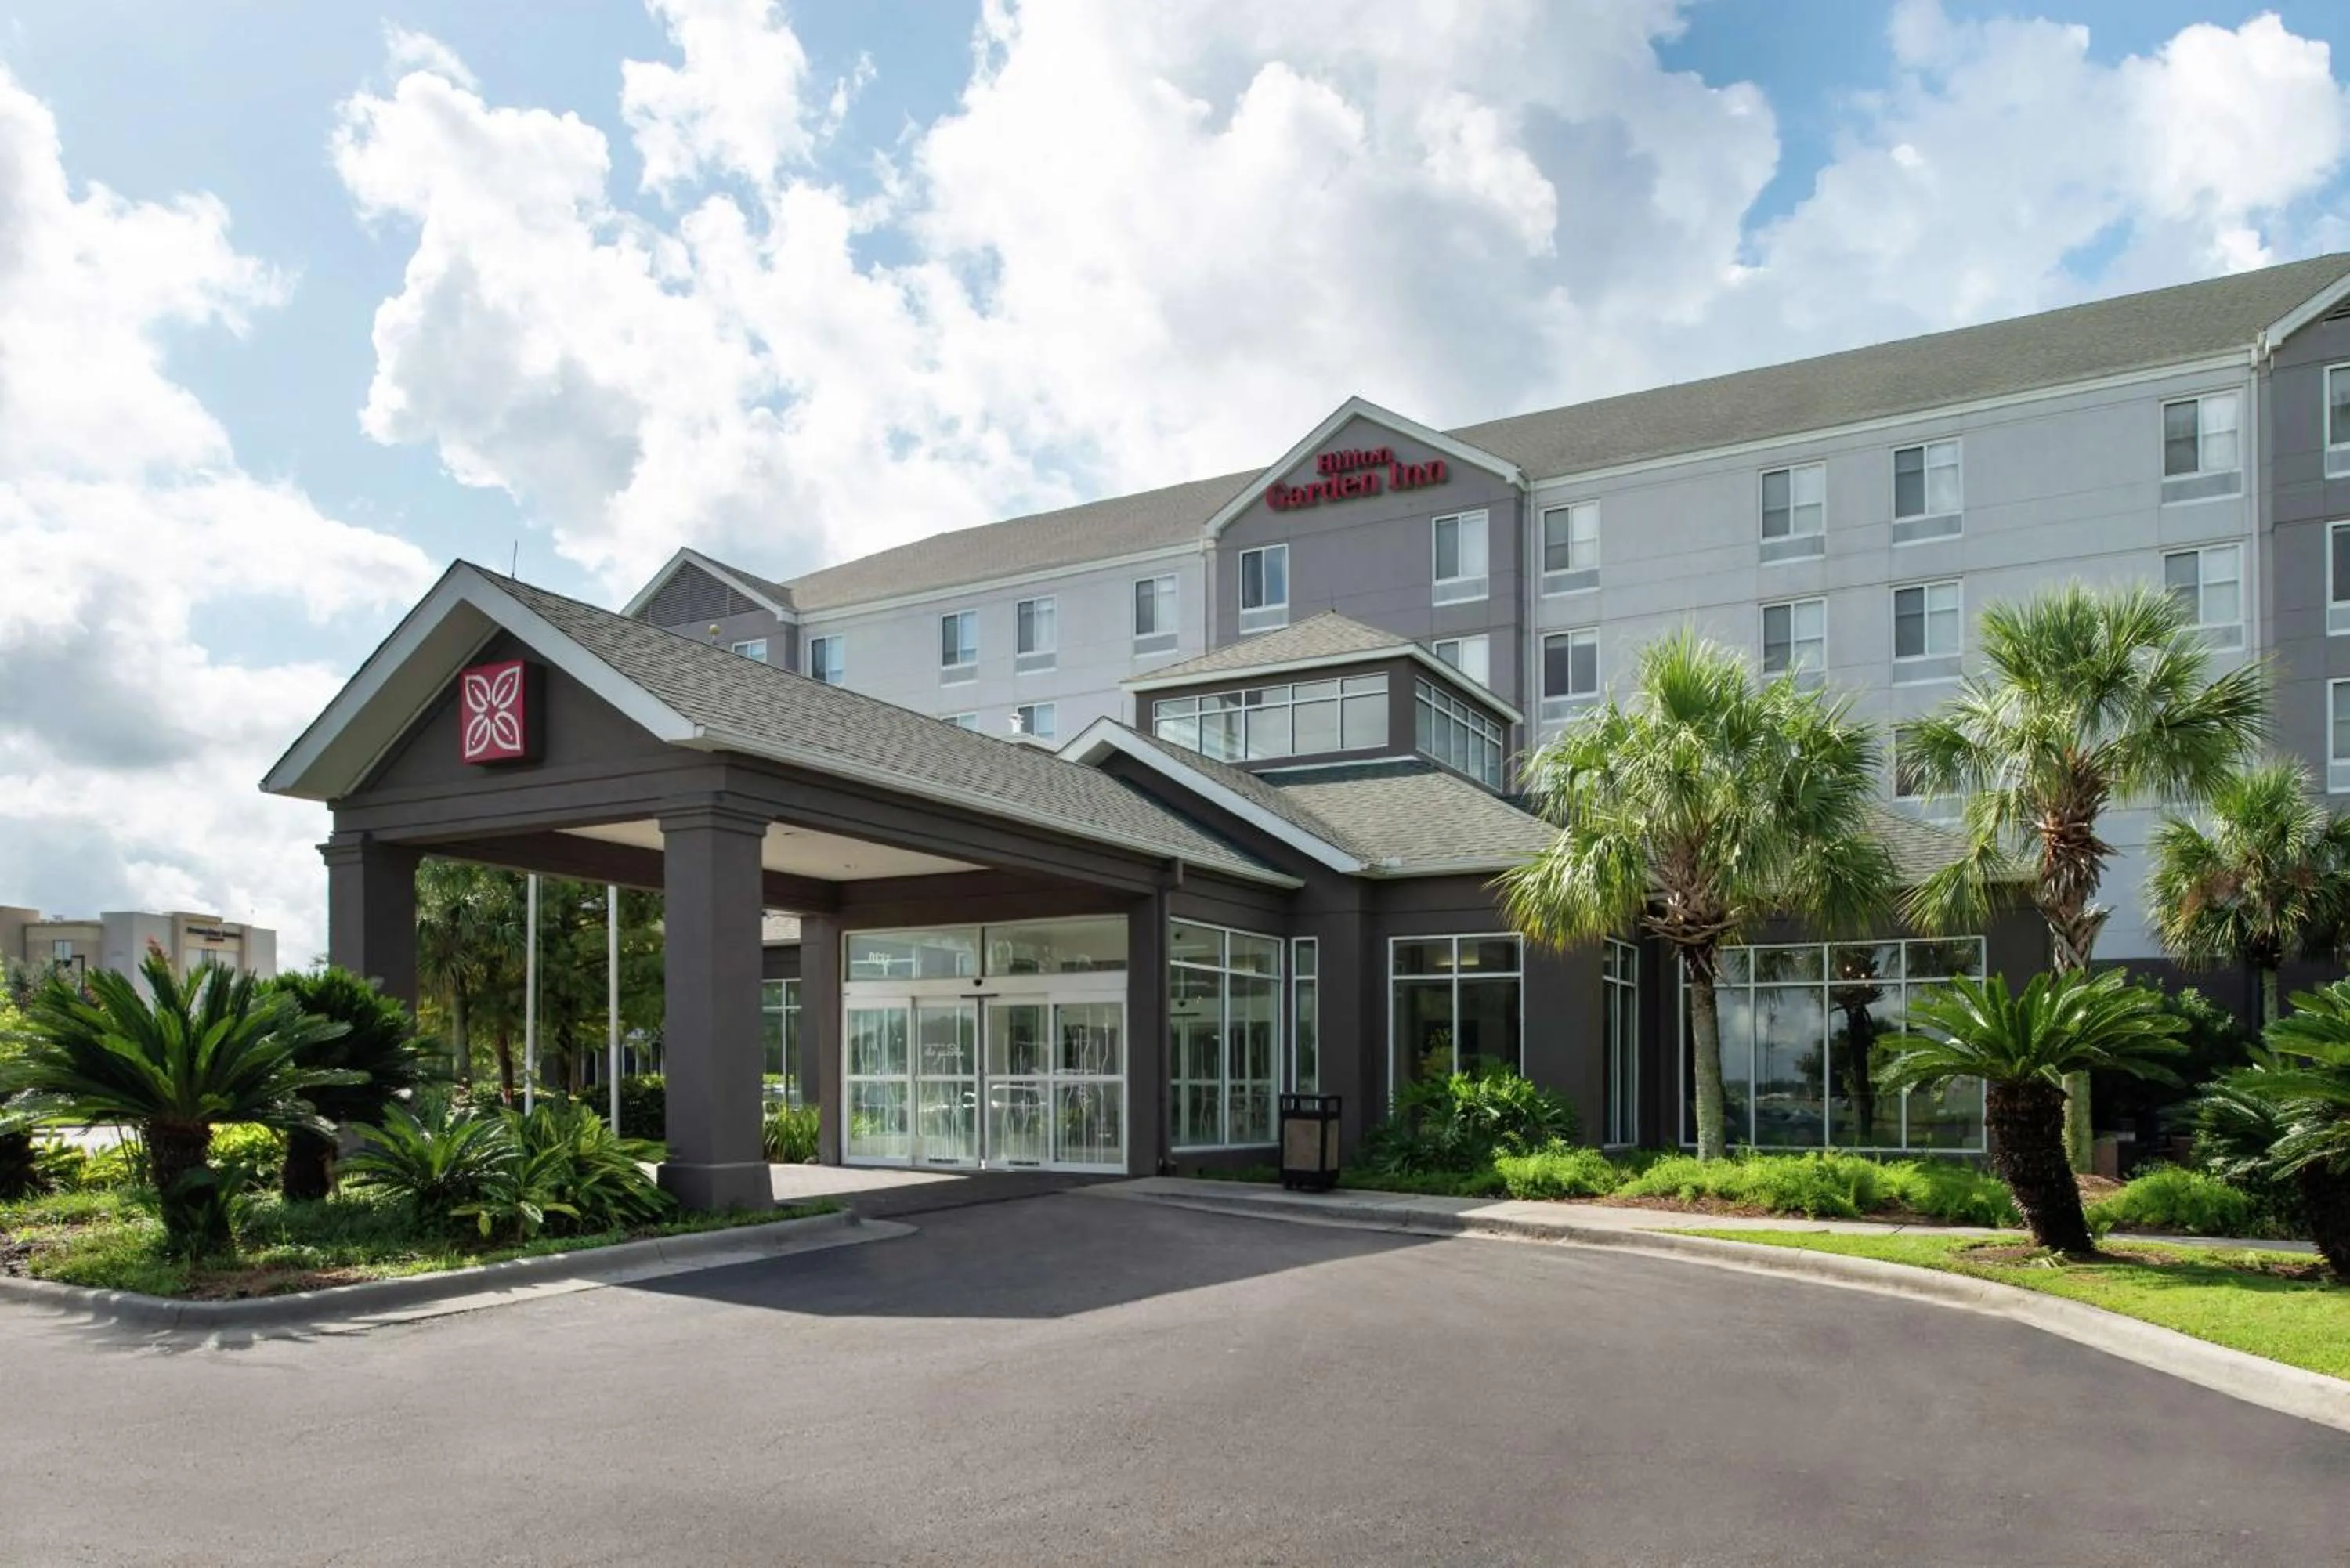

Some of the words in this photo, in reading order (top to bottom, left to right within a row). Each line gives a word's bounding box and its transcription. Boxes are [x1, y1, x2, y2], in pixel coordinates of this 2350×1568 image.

[1318, 446, 1393, 472] Hilton
[1266, 472, 1379, 511] Garden
[1388, 460, 1446, 490] Inn
